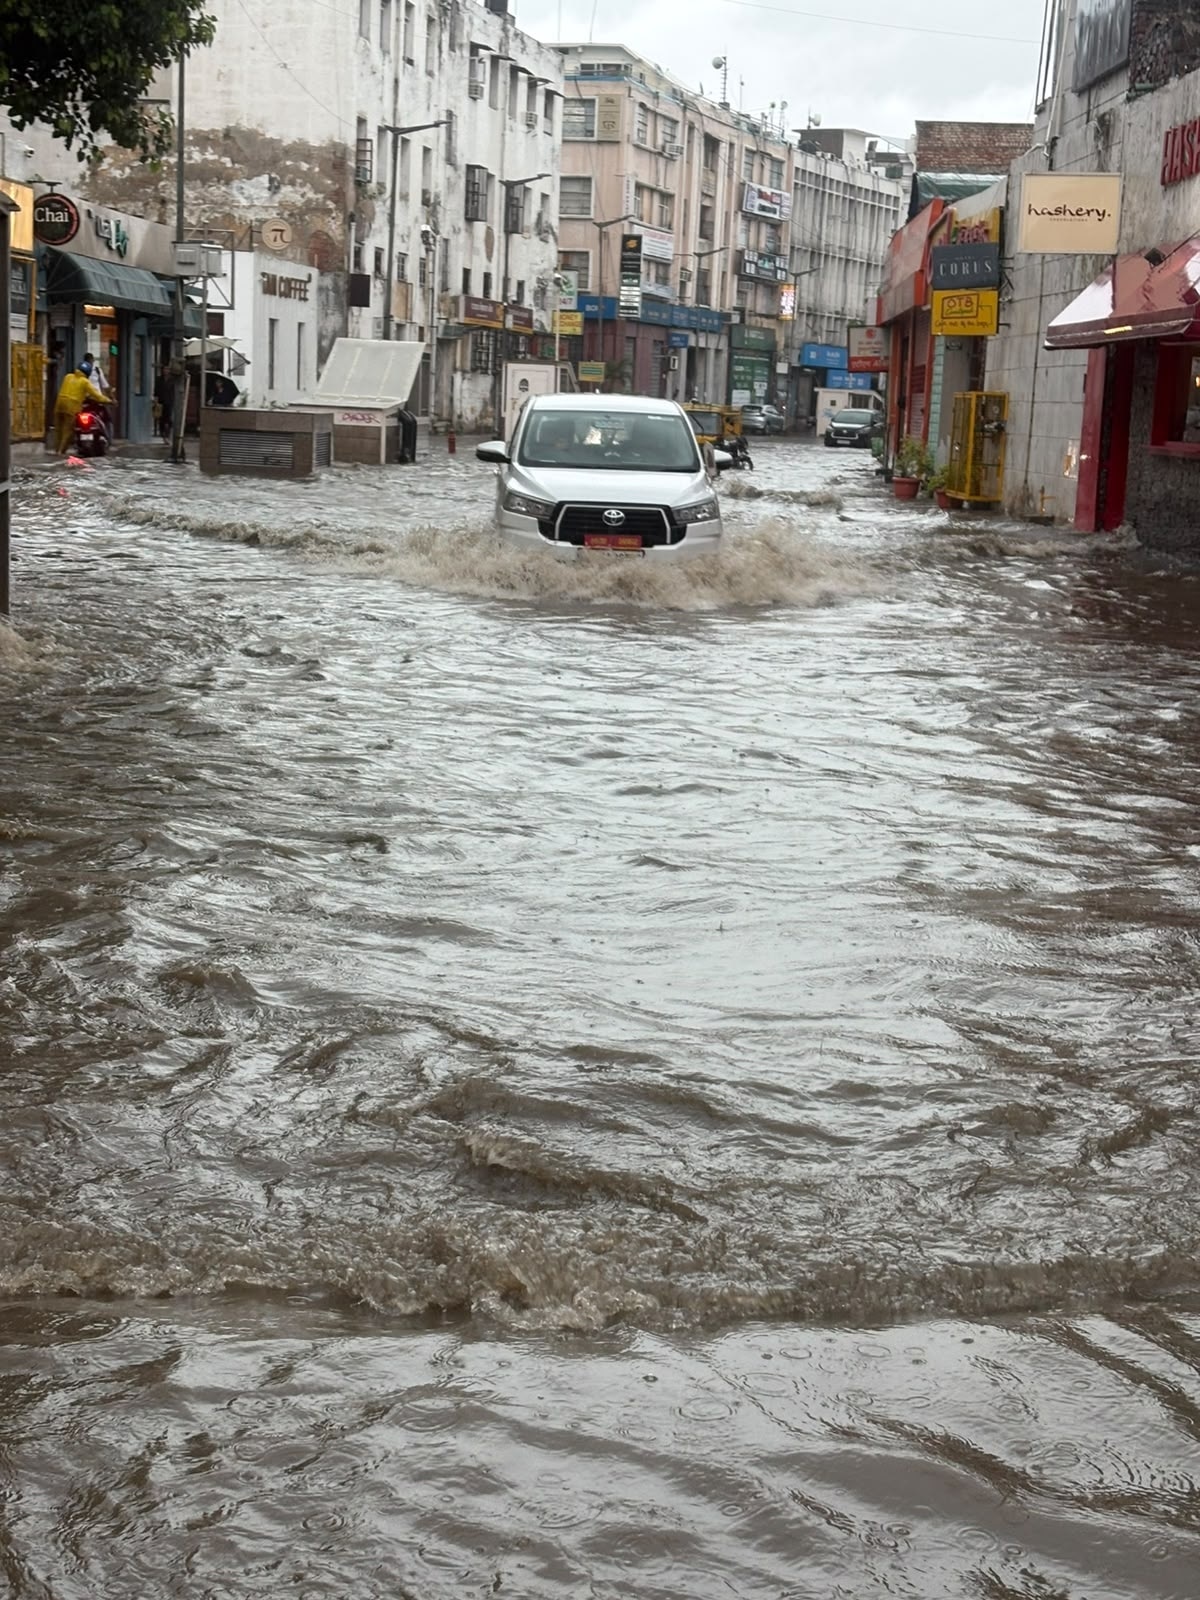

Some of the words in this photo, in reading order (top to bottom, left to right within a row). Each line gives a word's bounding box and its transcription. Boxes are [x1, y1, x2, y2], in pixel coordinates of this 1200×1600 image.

[34, 207, 69, 222] Chai
[1028, 203, 1111, 221] hashery.
[940, 260, 993, 276] CORUS
[279, 273, 312, 302] COFFEE
[947, 296, 974, 308] OTB
